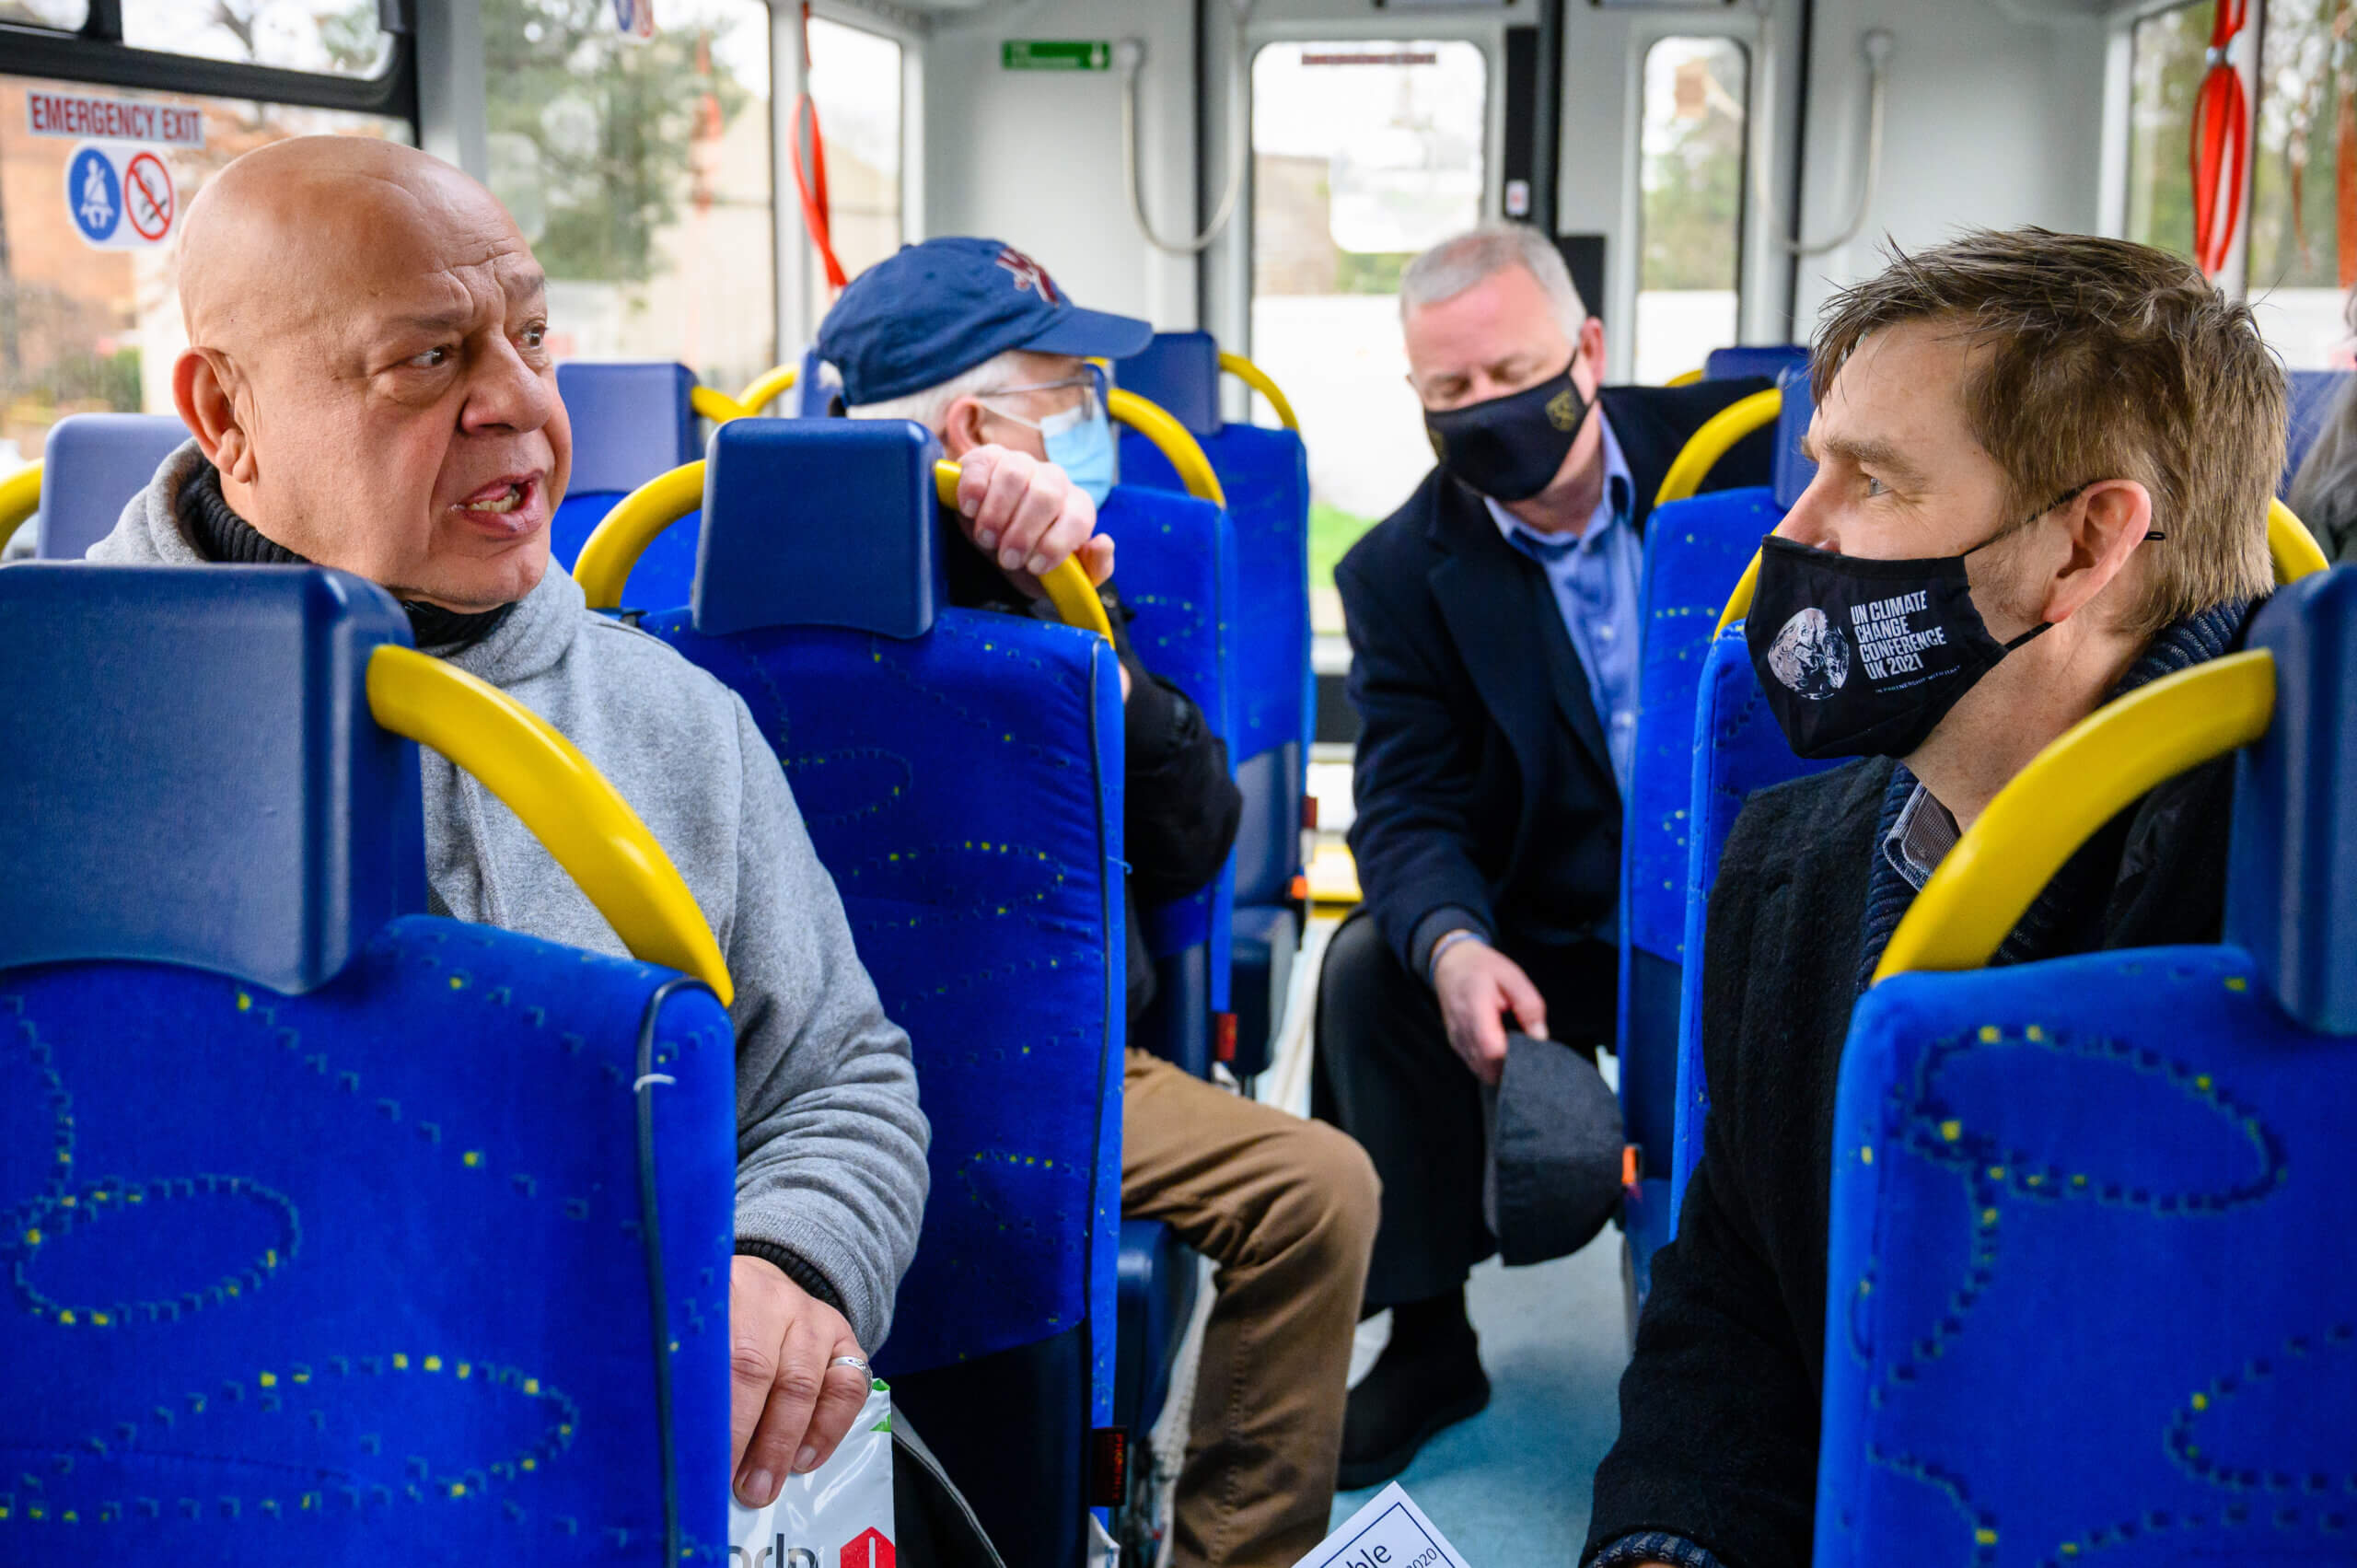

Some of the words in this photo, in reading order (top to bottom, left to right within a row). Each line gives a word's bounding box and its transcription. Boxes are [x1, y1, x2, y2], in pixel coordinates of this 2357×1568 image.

[31, 95, 155, 138] EMERGENCY
[162, 109, 200, 141] EXIT
[1851, 604, 1868, 625] UN
[1868, 590, 1927, 620] CLIMATE
[1854, 615, 1910, 645] CHANGE
[1859, 626, 1947, 663] CONFERENCE
[1864, 661, 1887, 680] UK
[1887, 653, 1924, 675] 2021
[1406, 1548, 1437, 1568] 020
